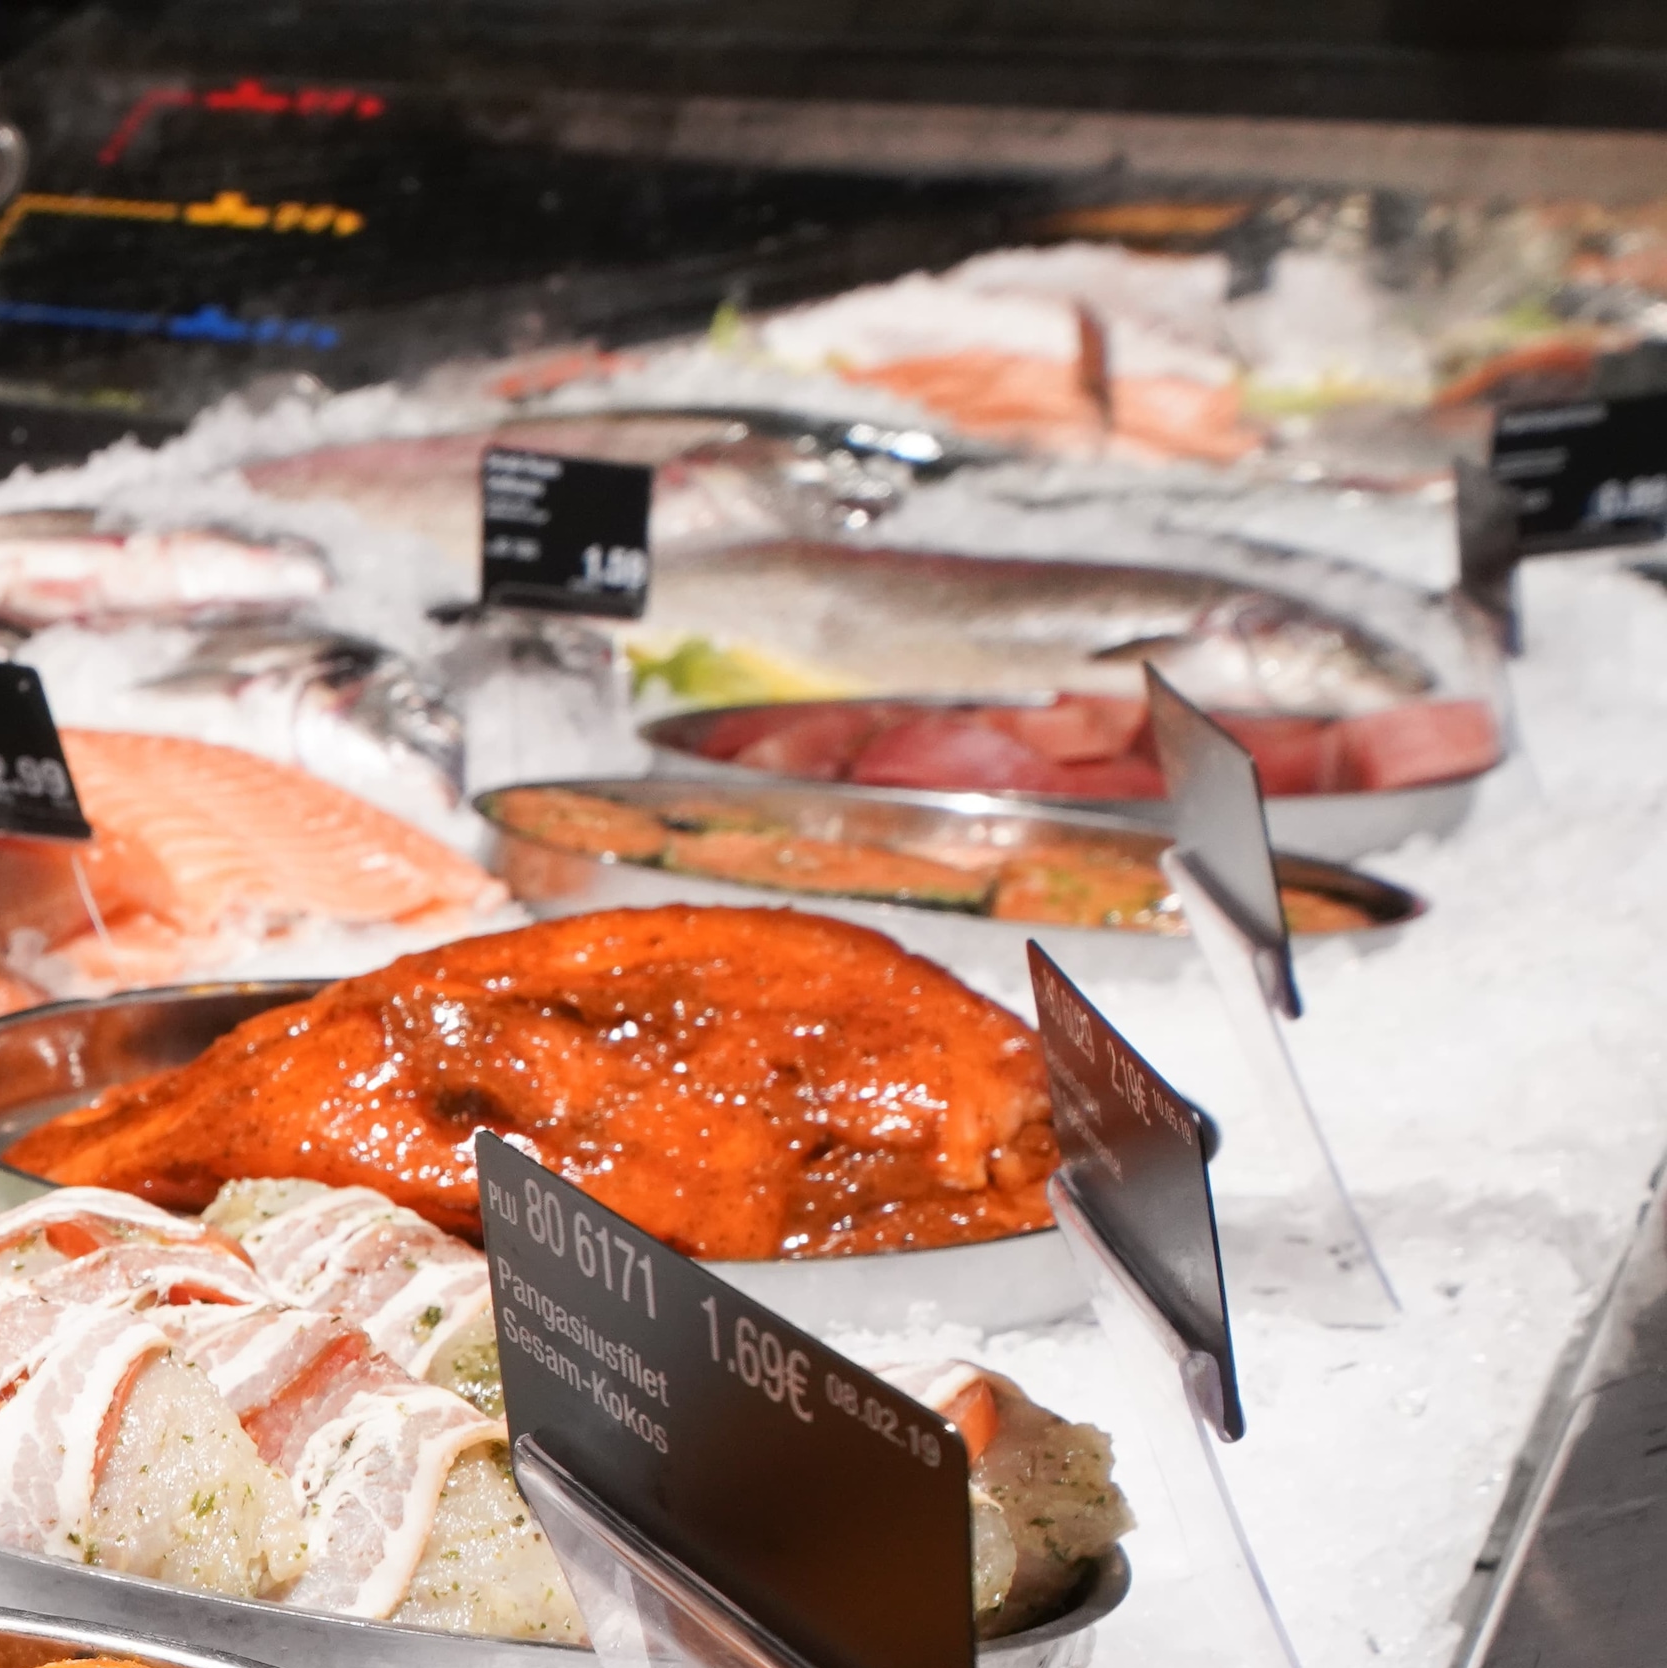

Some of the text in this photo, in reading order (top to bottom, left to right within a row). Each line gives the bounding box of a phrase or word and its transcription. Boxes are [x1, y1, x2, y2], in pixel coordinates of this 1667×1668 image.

[488, 1180, 517, 1226] PLU
[525, 1179, 565, 1257] 80
[574, 1211, 656, 1320] 6171
[701, 1296, 814, 1423] 1.69€
[497, 1255, 670, 1407] Pangasiusfilet
[503, 1307, 669, 1454] Sesam-Kokos
